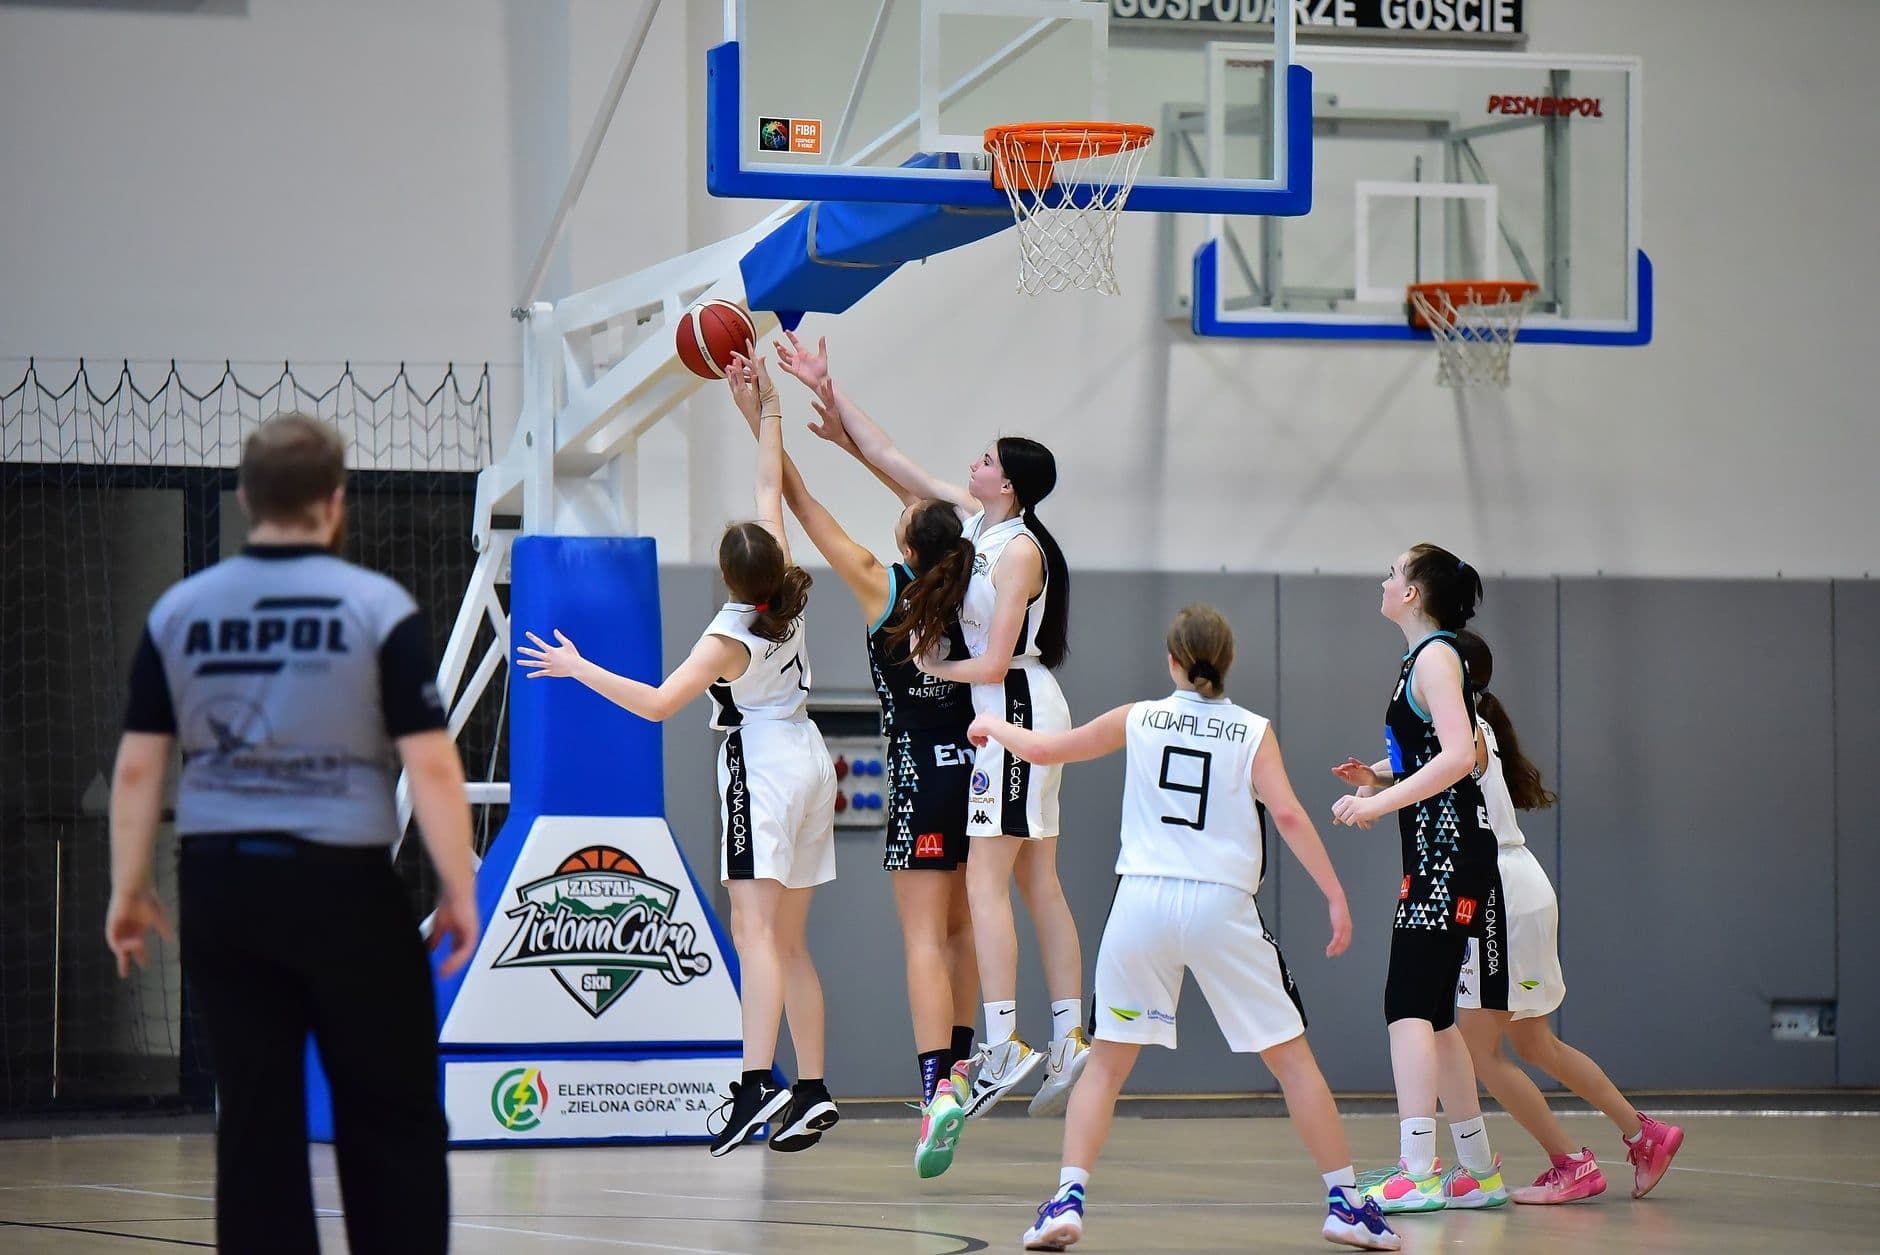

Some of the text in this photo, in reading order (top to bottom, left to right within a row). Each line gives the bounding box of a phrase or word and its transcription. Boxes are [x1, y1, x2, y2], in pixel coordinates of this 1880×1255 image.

[795, 125, 816, 136] FIBA
[185, 618, 350, 656] ARPOL
[1142, 709, 1248, 743] KOWALSKA
[1159, 745, 1211, 831] 9
[733, 813, 747, 856] GÓRA
[568, 879, 635, 897] ZASTAL
[1486, 940, 1500, 976] GÓRA
[582, 974, 612, 991] SKM
[558, 1082, 716, 1097] ELEKTROCIEPŁOWNIA
[685, 1100, 711, 1112] S.A.
